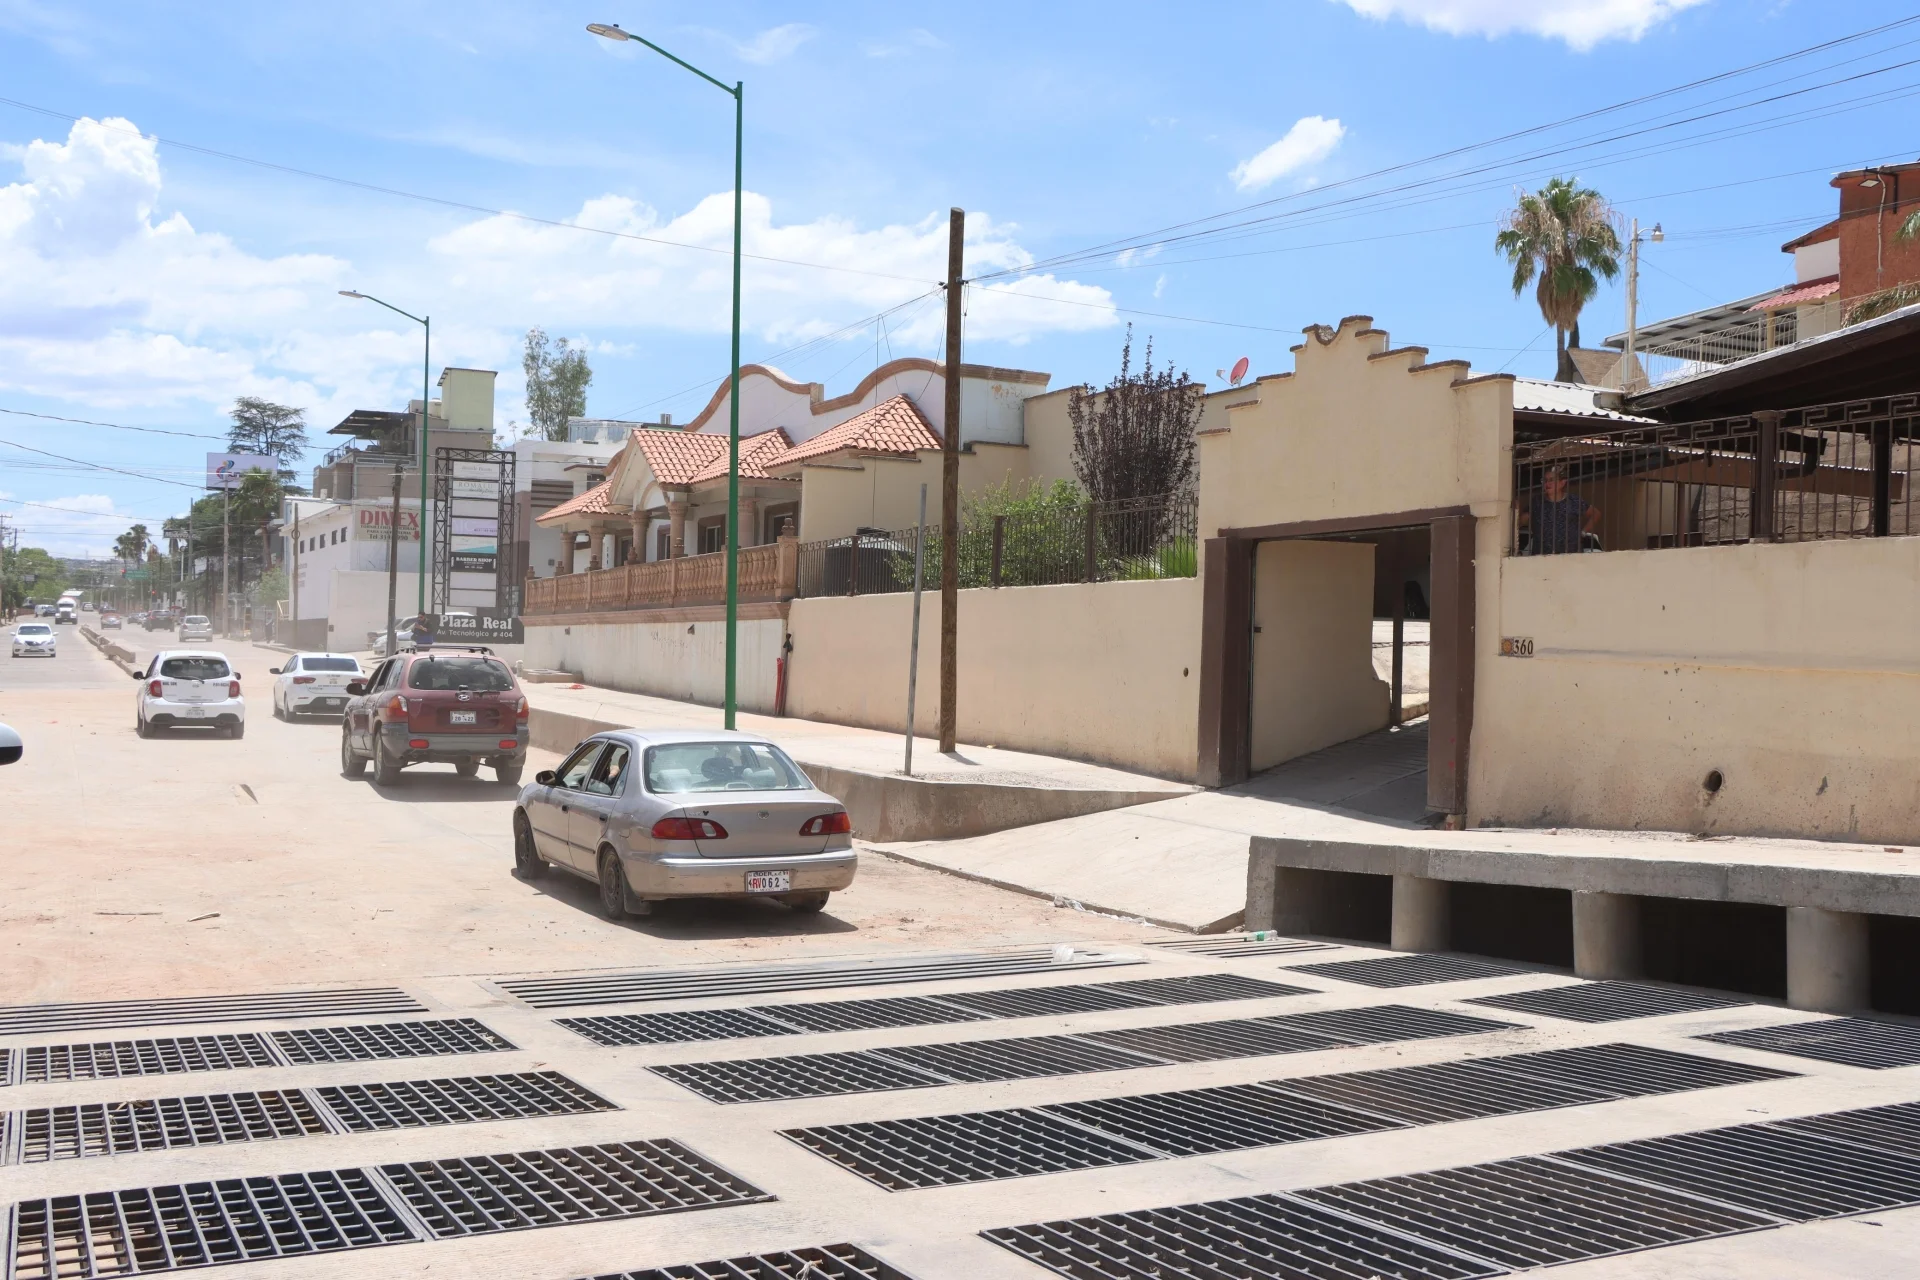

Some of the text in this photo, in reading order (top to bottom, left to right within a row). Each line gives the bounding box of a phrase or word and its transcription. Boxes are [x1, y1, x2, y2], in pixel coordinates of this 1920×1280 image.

[360, 510, 419, 527] DIMEX
[439, 615, 512, 629] Plaza Real
[449, 629, 489, 637] Tecnológico
[1514, 639, 1533, 655] 360
